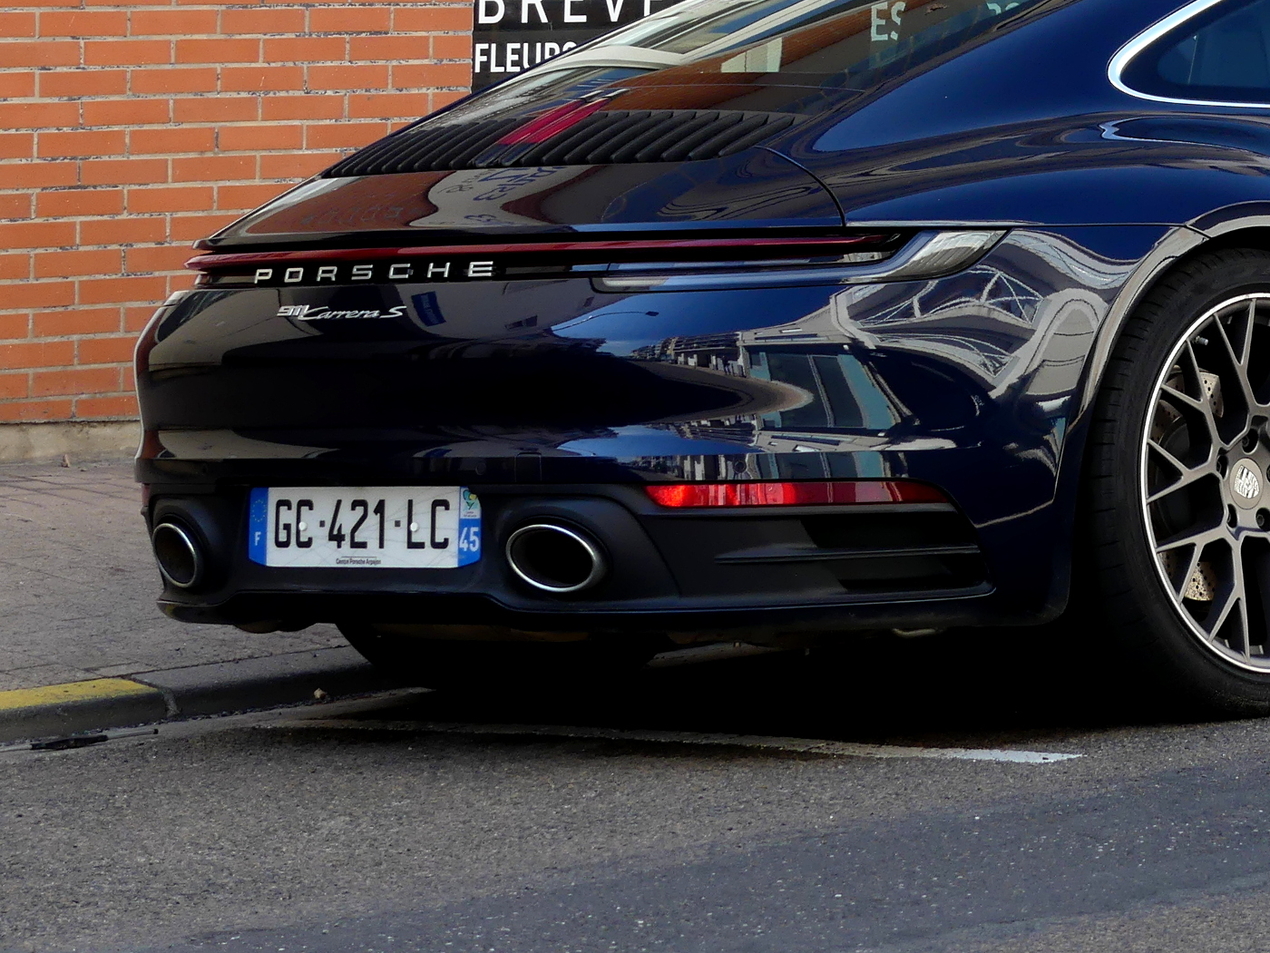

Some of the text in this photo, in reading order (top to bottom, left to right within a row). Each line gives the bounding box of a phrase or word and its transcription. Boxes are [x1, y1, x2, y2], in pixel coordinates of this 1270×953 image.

[254, 261, 494, 285] PORSCHE
[298, 305, 381, 321] Carrera
[380, 305, 408, 319] S
[254, 531, 262, 546] F
[458, 526, 480, 553] 45
